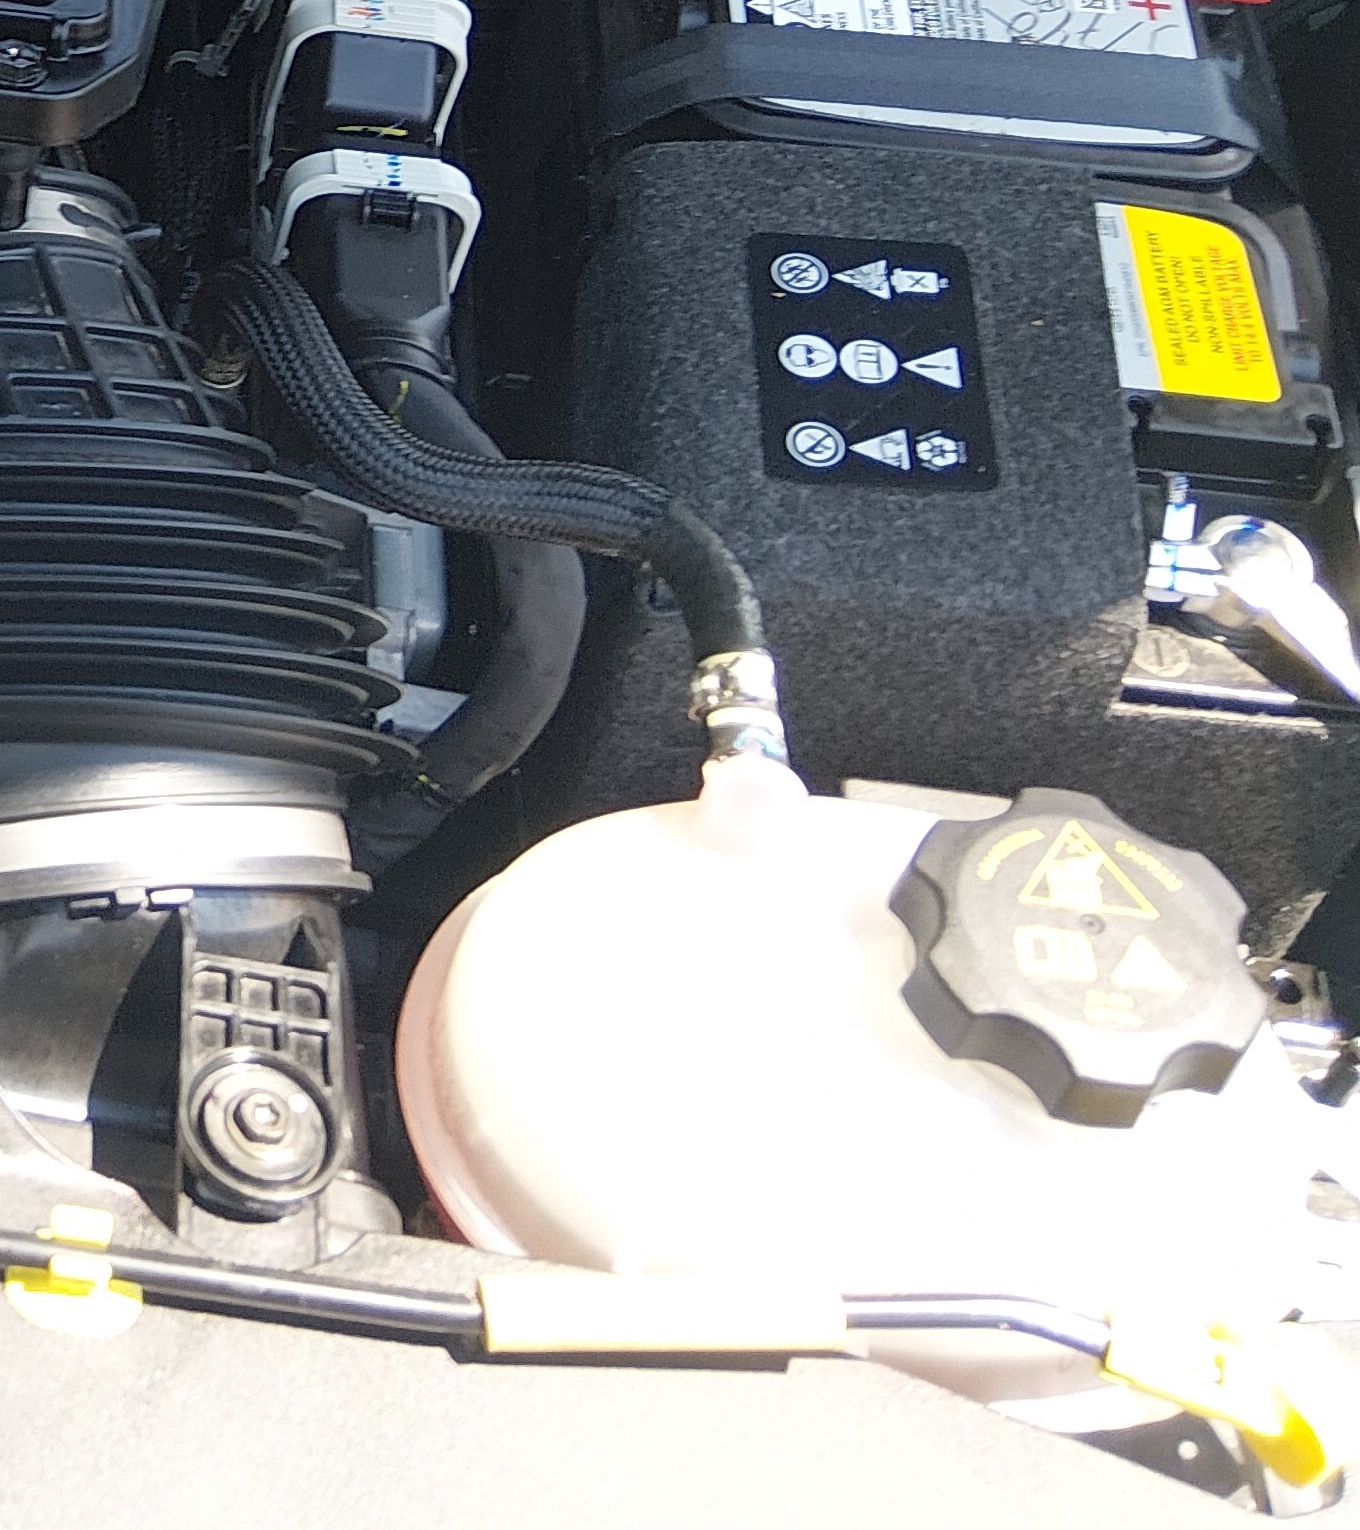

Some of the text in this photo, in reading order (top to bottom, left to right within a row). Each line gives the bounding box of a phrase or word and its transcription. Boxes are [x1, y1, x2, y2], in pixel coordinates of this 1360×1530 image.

[1148, 231, 1188, 366] SEALED AGM BATTERY
[1177, 298, 1194, 323] NOT
[1206, 245, 1248, 372] LIMIT CHARGE VOLTAGE
[1231, 285, 1252, 321] VOLTS
[1185, 324, 1199, 343] DO
[1248, 349, 1263, 363] TO
